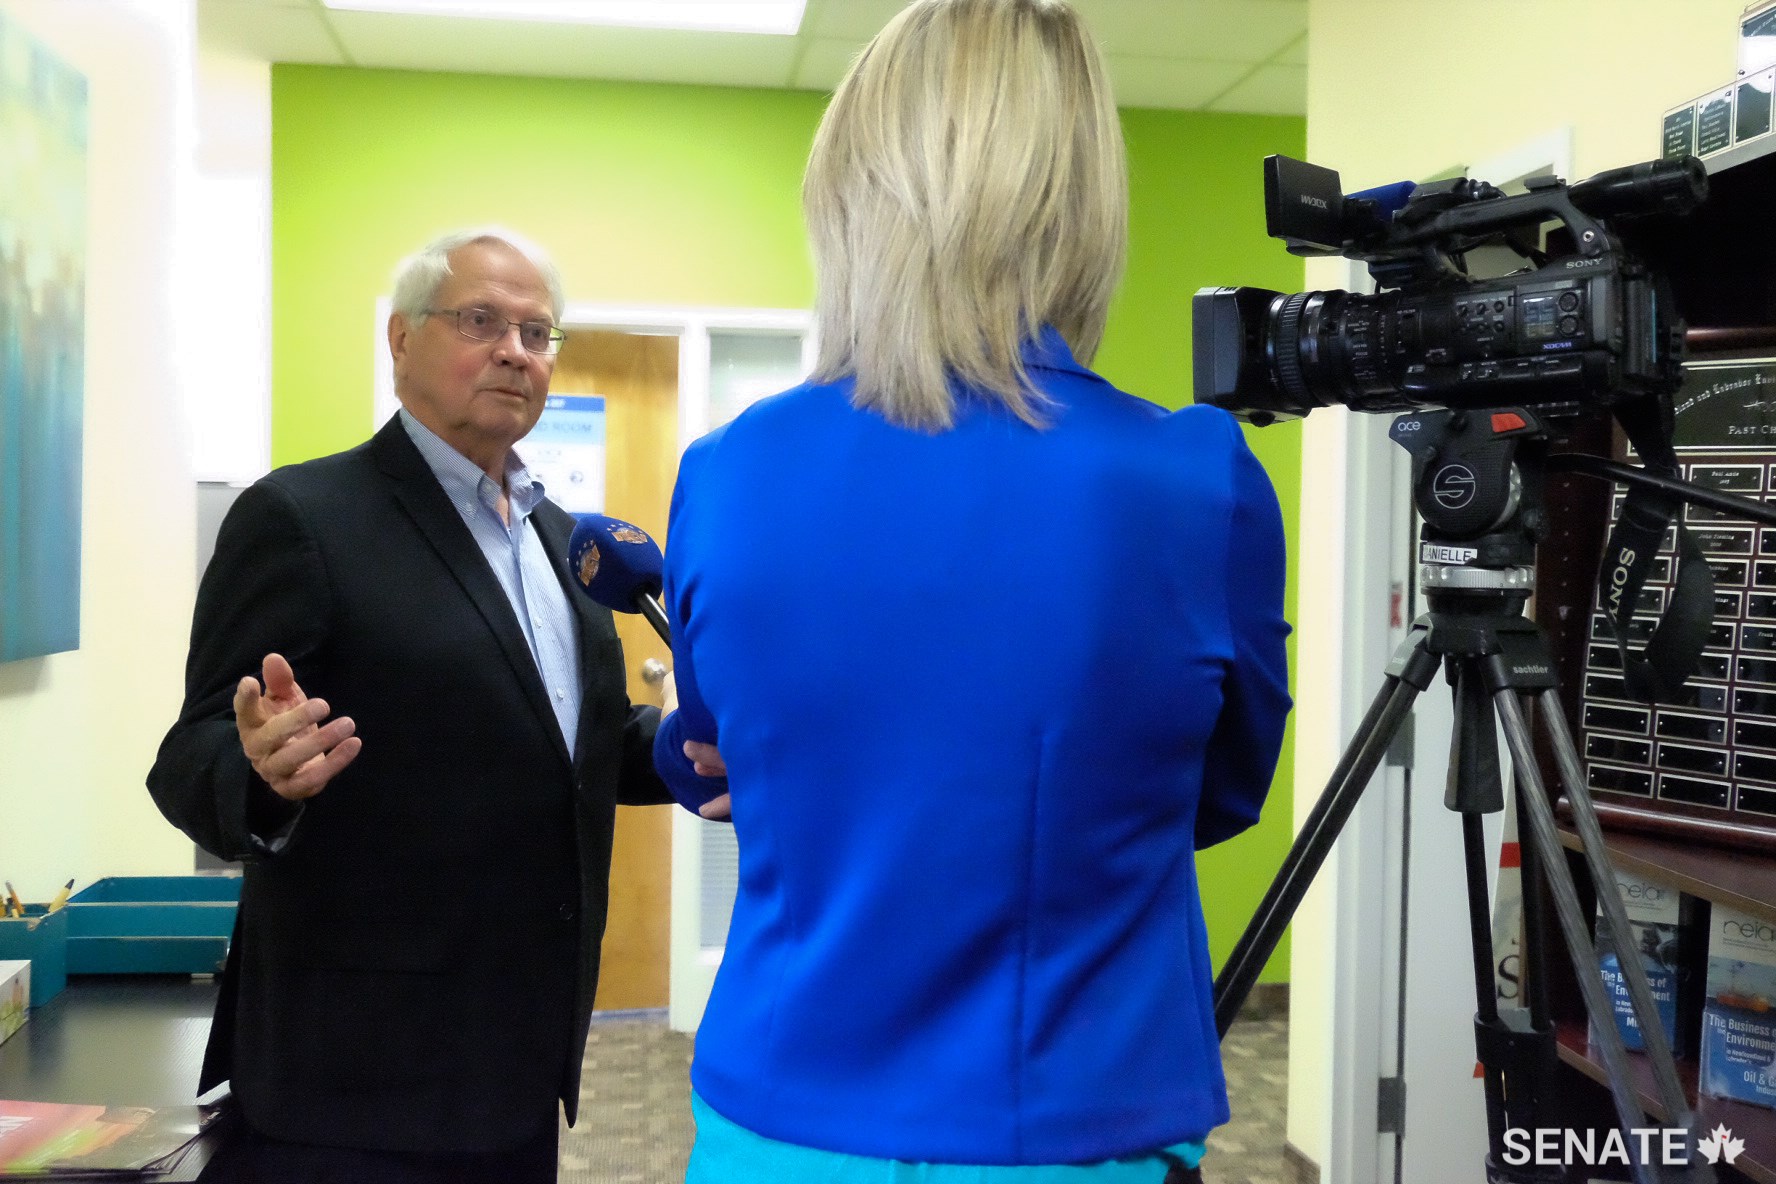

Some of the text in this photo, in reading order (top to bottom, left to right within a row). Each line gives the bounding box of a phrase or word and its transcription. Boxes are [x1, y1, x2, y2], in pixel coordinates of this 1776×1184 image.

[1566, 257, 1603, 269] SONY
[1397, 421, 1421, 432] ace
[1728, 425, 1757, 435] PAST
[1609, 547, 1636, 623] SONY
[1512, 664, 1549, 674] sachtler
[1600, 970, 1616, 982] The
[1709, 1013, 1726, 1028] The
[1728, 1018, 1770, 1037] Business
[1743, 1070, 1756, 1084] Oil
[1758, 1073, 1766, 1085] &
